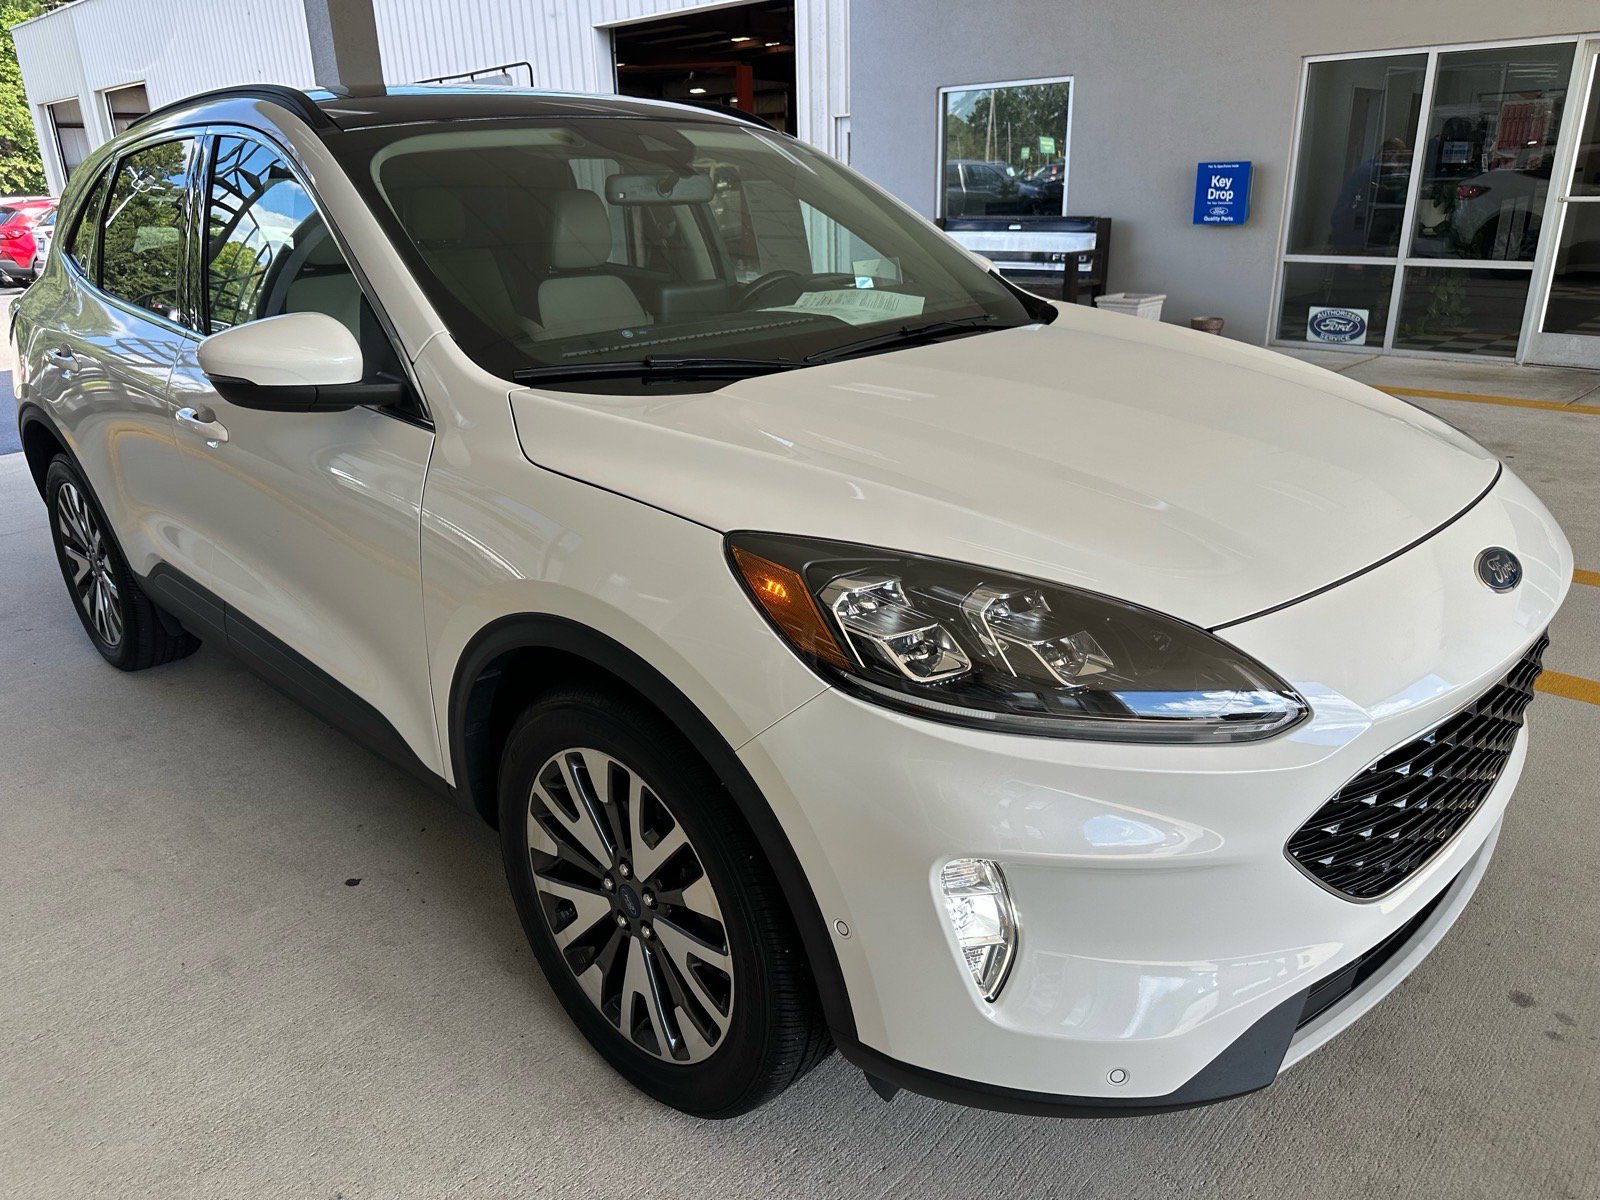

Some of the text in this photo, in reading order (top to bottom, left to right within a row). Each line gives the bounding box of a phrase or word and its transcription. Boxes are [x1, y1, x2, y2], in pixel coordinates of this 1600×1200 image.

[1211, 175, 1233, 190] Key
[1207, 188, 1234, 202] Drop
[1203, 215, 1221, 223] Quality
[1052, 253, 1087, 262] FOD
[1317, 310, 1361, 322] AUTHORIZED
[1320, 318, 1355, 332] Ford
[1319, 333, 1351, 342] SERVICE
[1486, 554, 1517, 584] Ford
